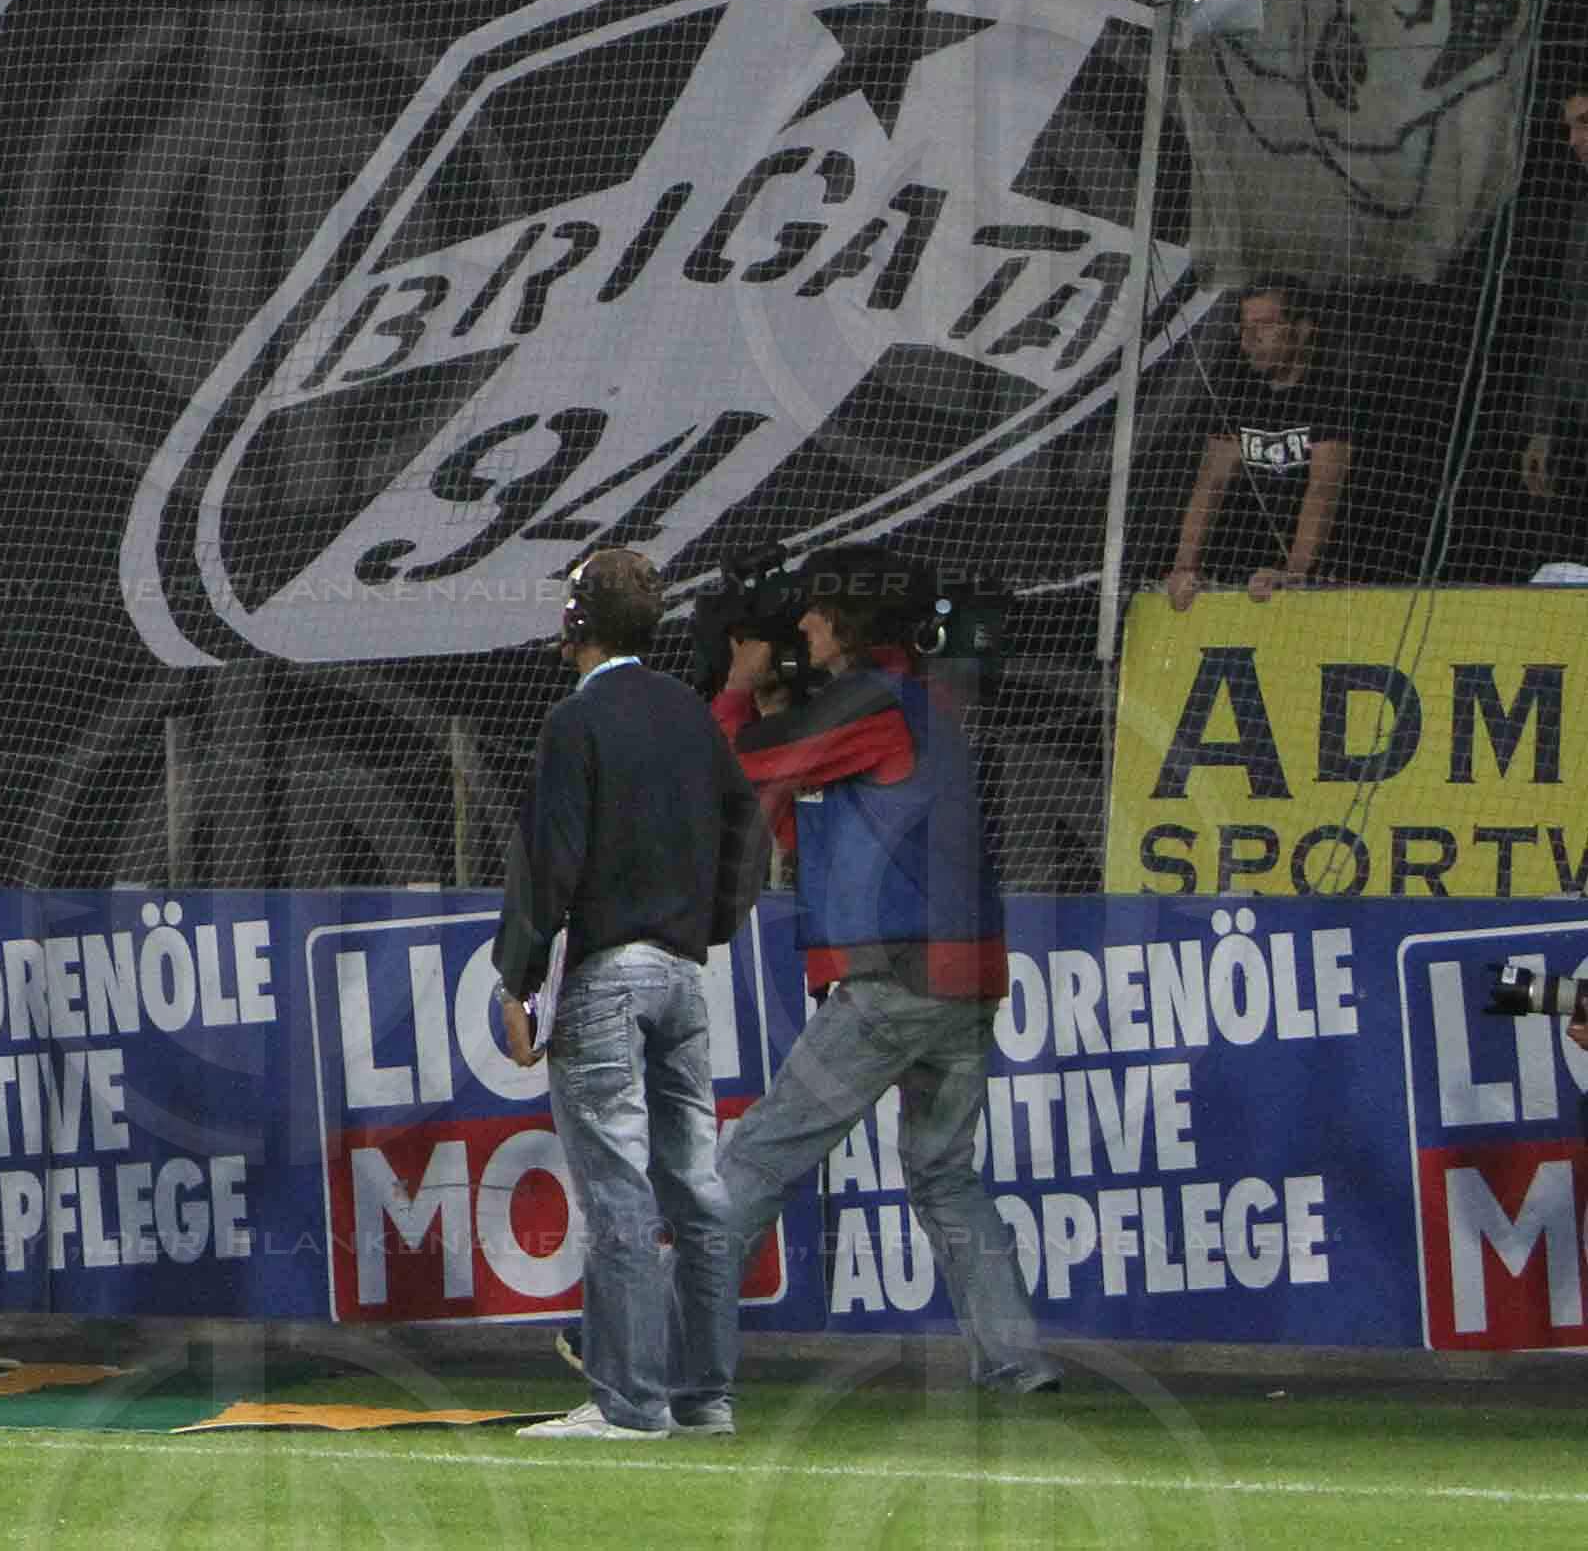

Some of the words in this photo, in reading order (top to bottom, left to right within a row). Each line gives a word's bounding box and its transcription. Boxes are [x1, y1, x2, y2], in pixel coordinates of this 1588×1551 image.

[300, 146, 1133, 390] BRIGATA
[357, 408, 774, 587] 94
[992, 907, 1359, 1062] ORENÖLE
[352, 1129, 589, 1305] MO
